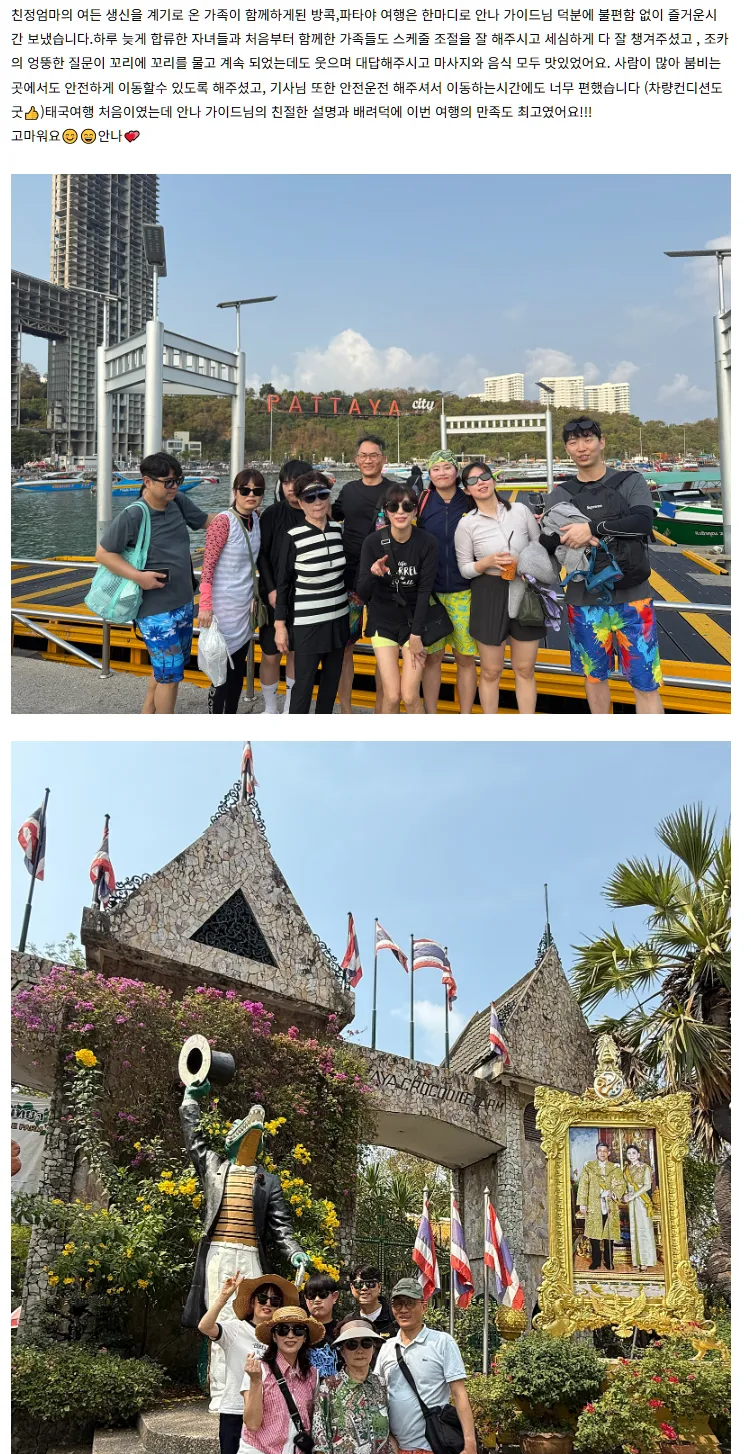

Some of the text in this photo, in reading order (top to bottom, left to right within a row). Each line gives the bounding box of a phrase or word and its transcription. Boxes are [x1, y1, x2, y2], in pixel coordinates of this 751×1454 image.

[267, 394, 435, 416] PATTAYA city
[399, 1077, 473, 1106] CROCODILE
